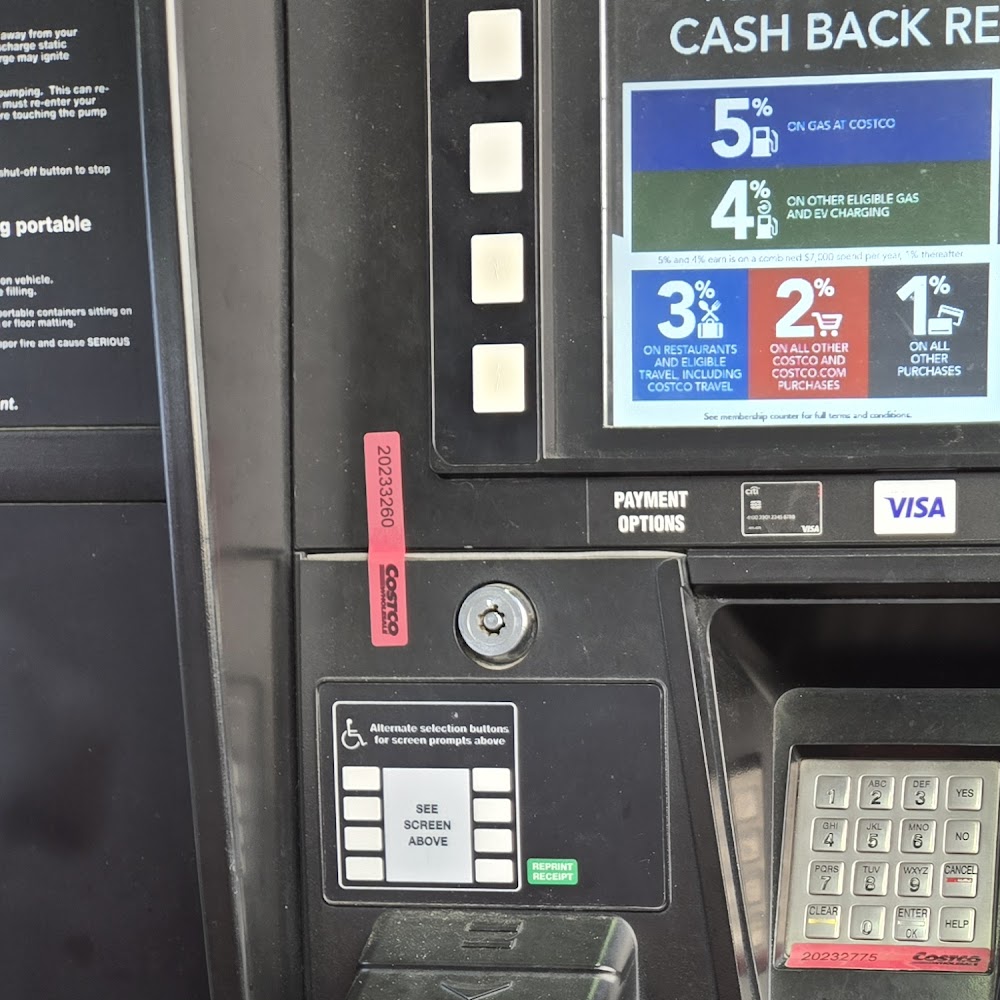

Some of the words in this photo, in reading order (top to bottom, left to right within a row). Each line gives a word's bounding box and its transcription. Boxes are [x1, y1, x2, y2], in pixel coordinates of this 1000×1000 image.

[1, 31, 26, 41] away
[28, 29, 52, 39] from
[55, 29, 78, 39] your
[669, 12, 790, 56] CASH
[806, 8, 931, 52] BACK
[12, 109, 56, 120] touching
[59, 108, 75, 118] the
[78, 108, 107, 119] pump
[0, 166, 37, 177] shut-off
[40, 166, 72, 176] button
[75, 165, 86, 174] to
[88, 165, 110, 175] stop
[786, 195, 805, 206] ON
[807, 194, 845, 205] OTHER
[847, 193, 893, 205] ELIGIBLE
[896, 192, 919, 203] GAS
[786, 208, 812, 219] AND
[814, 208, 829, 219] EV
[830, 206, 890, 218] CHARGING
[16, 215, 92, 237] portable
[37, 308, 86, 317] containers
[88, 307, 118, 317] sitting
[20, 339, 35, 348] fire
[38, 338, 55, 348] and
[58, 339, 85, 347] cause
[87, 337, 130, 347] SERIOUS
[909, 341, 927, 352] ON
[930, 340, 950, 351] ALL
[910, 354, 949, 364] OTHER
[898, 366, 961, 377] PURCHASES
[377, 445, 395, 528] 20233260
[613, 490, 689, 510] PAYMENT
[888, 496, 947, 518] VISA
[617, 514, 685, 534] OPTIONS
[370, 724, 417, 733] Alternate
[420, 724, 467, 734] selection
[470, 724, 509, 734] buttons
[374, 735, 389, 745] for
[392, 737, 427, 745] screen
[429, 737, 472, 747] prompts
[474, 736, 505, 745] above
[956, 789, 974, 798] YES
[416, 804, 438, 814] SEE
[404, 821, 451, 830] SCREEN
[955, 831, 970, 841] NO
[408, 837, 448, 846] ABOVE
[532, 863, 574, 871] REPRINT
[944, 865, 977, 875] CANCEL
[532, 872, 574, 881] RECEIPT
[809, 906, 838, 916] CLEAR
[898, 909, 928, 918] ENTER
[945, 920, 969, 929] HELP
[801, 952, 877, 962] 20232775
